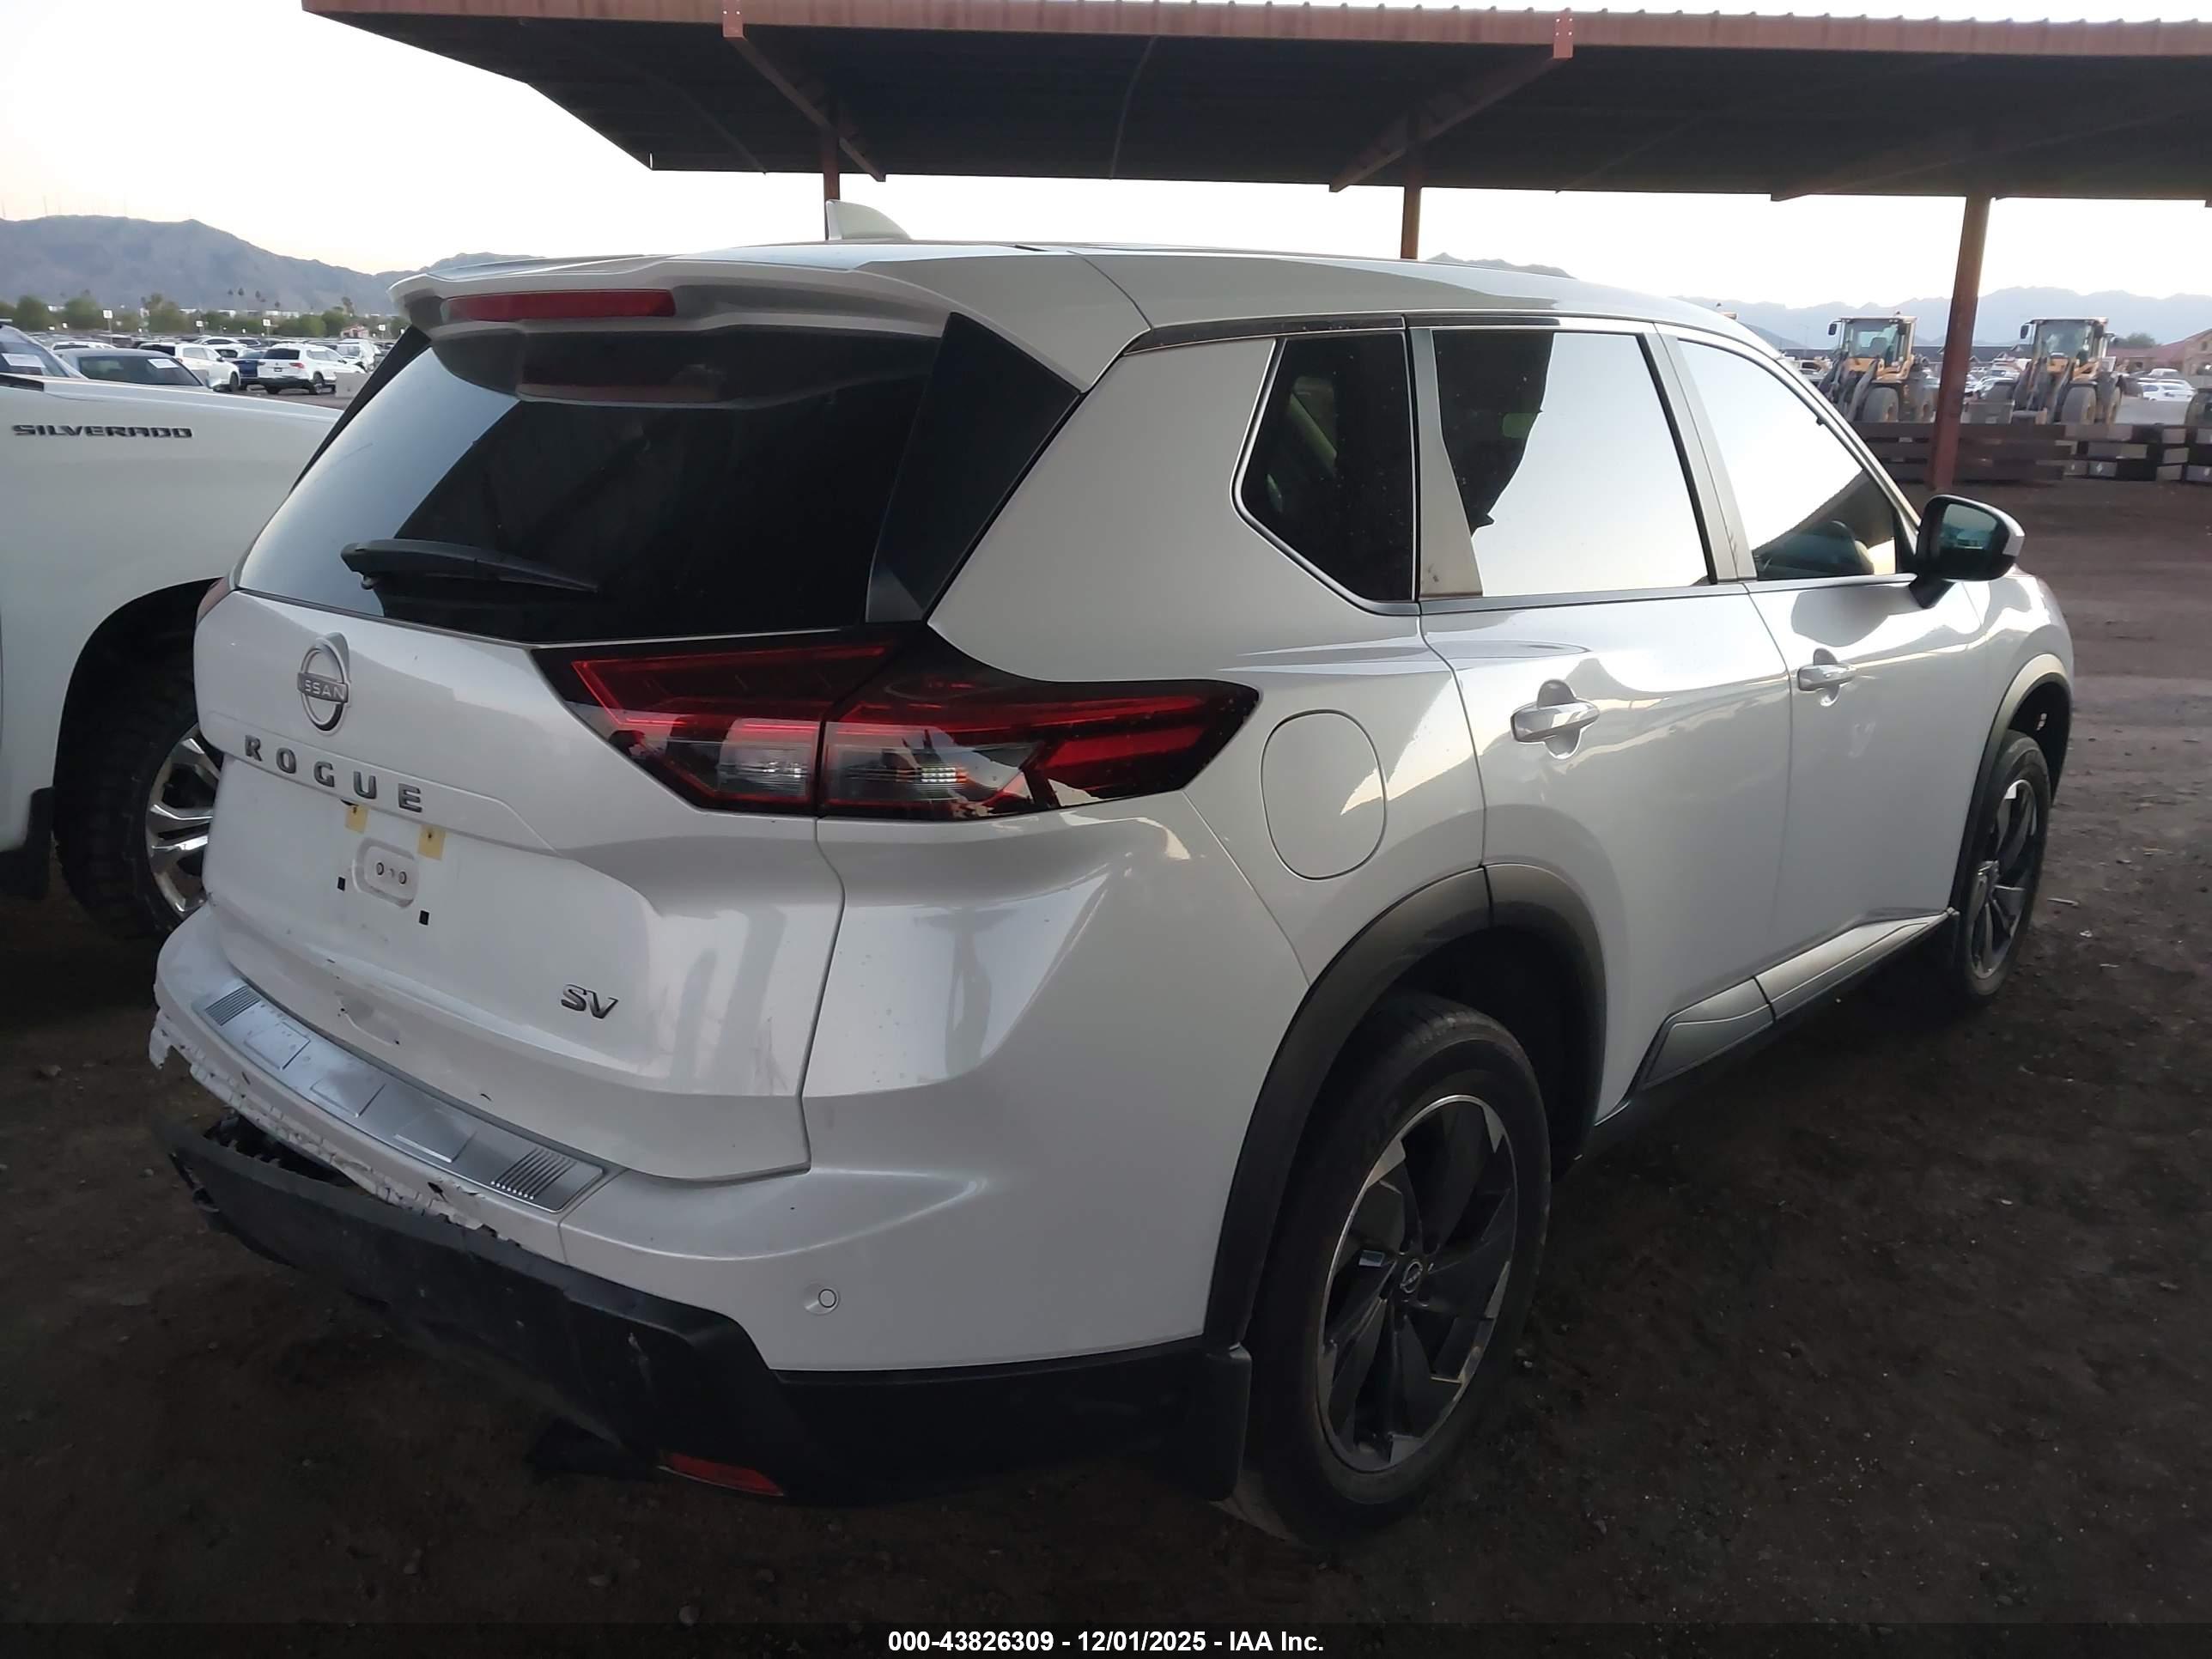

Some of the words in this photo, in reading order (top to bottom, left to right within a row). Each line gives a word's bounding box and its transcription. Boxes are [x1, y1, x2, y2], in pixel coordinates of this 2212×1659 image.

[12, 424, 193, 438] SILVERADO
[301, 678, 346, 701] SSAN
[245, 735, 422, 813] ROGUE
[561, 983, 619, 1019] SV
